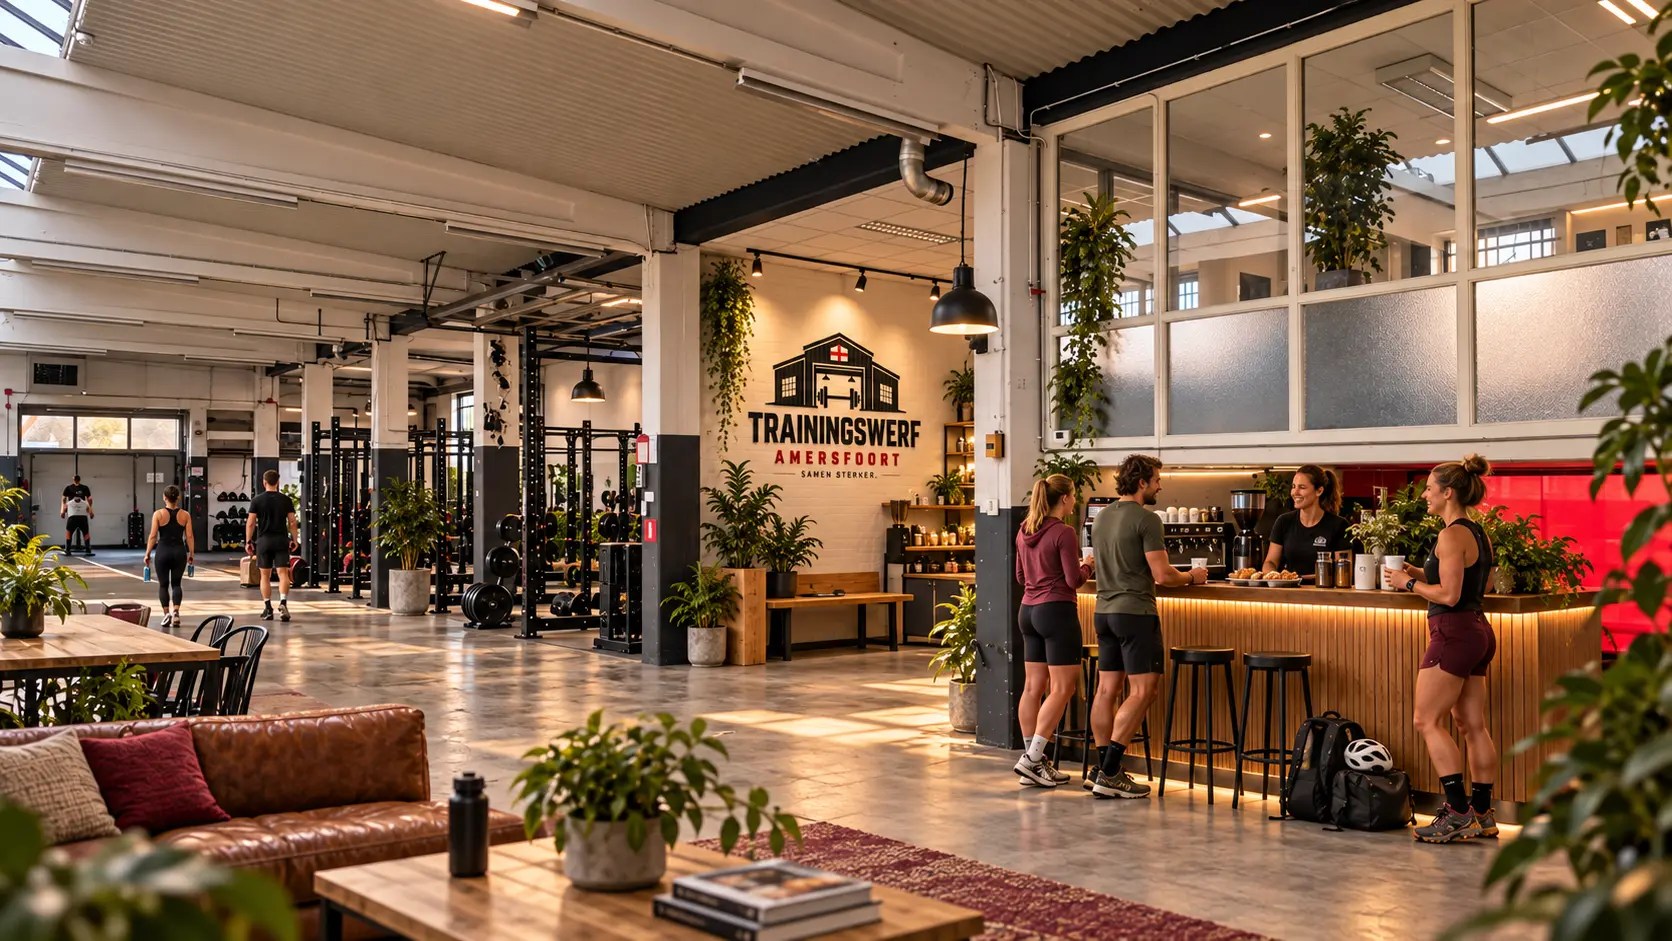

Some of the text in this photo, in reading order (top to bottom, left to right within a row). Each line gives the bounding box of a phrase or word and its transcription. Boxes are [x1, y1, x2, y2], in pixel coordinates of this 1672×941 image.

[748, 412, 921, 448] TRAININGSWERF
[774, 449, 900, 467] AMERSFOORT
[801, 470, 878, 479] SAMEN STERKER.
